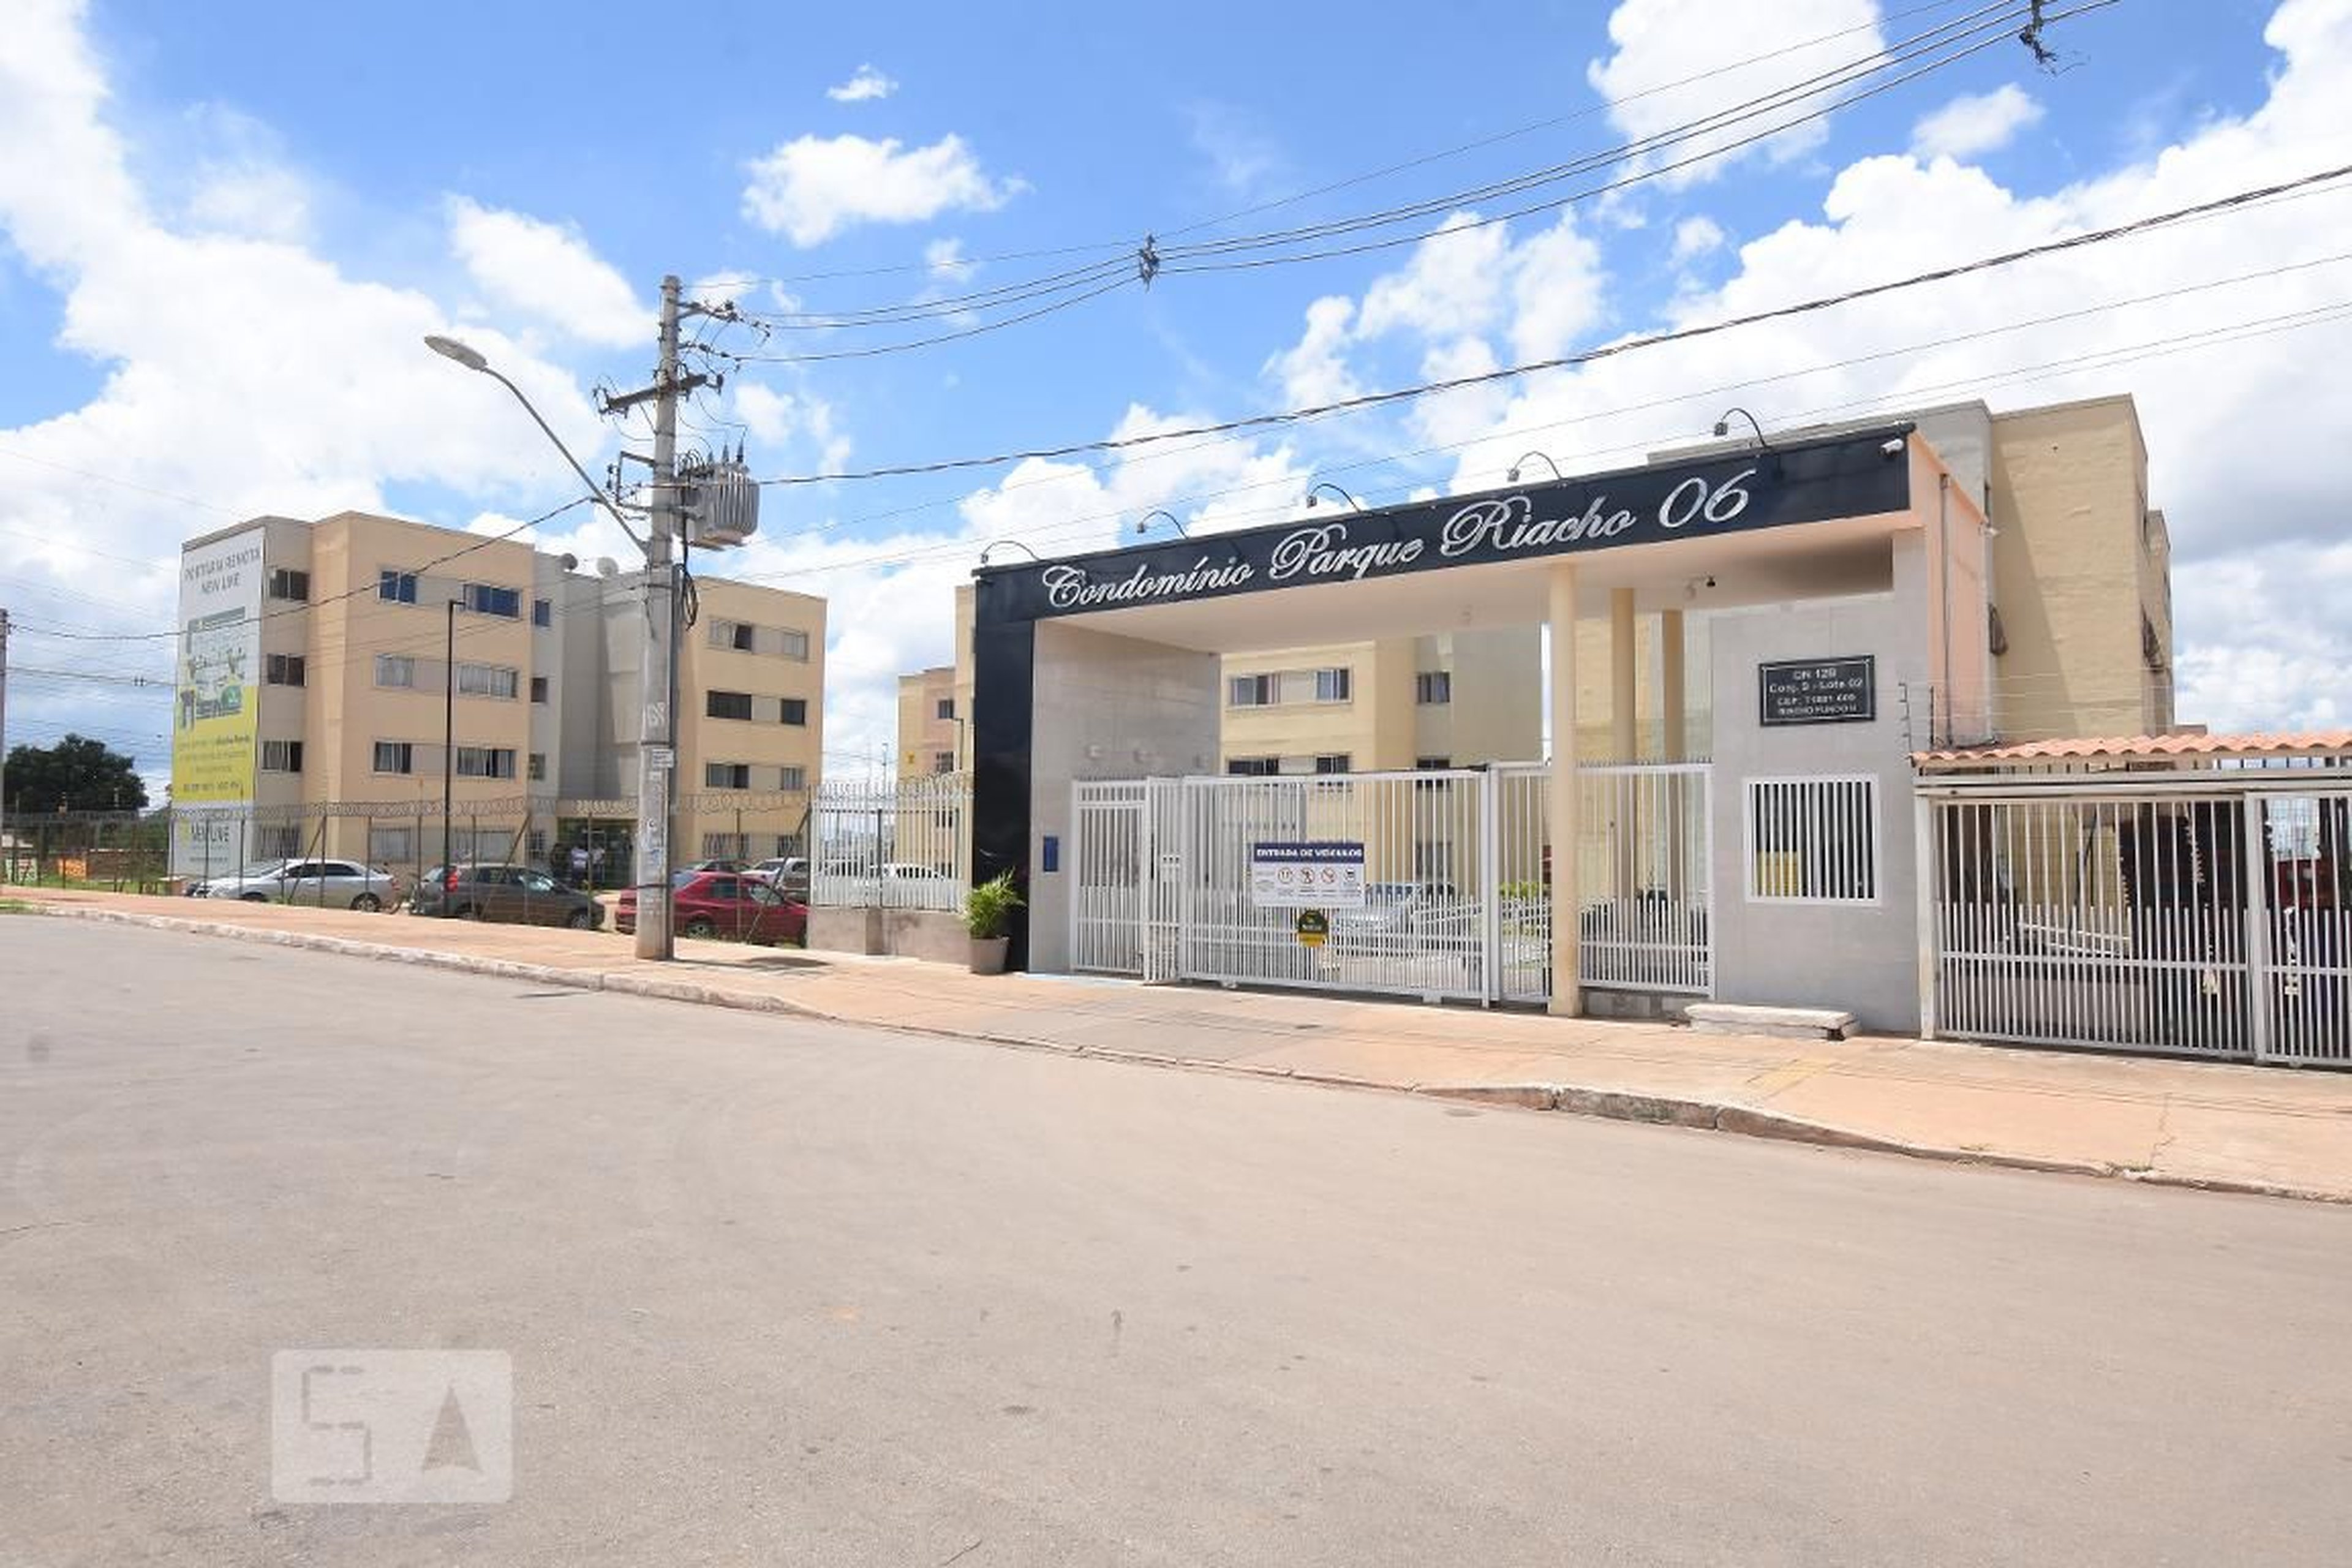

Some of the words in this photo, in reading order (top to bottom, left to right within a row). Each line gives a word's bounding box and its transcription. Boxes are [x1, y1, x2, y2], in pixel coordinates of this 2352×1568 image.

[1042, 555, 1254, 608] Condomínio
[1269, 523, 1424, 579] Parque
[1441, 496, 1637, 557] Riacho
[1659, 469, 1757, 528] 06
[1256, 848, 1298, 857] ENTRADA
[1300, 848, 1313, 857] DE
